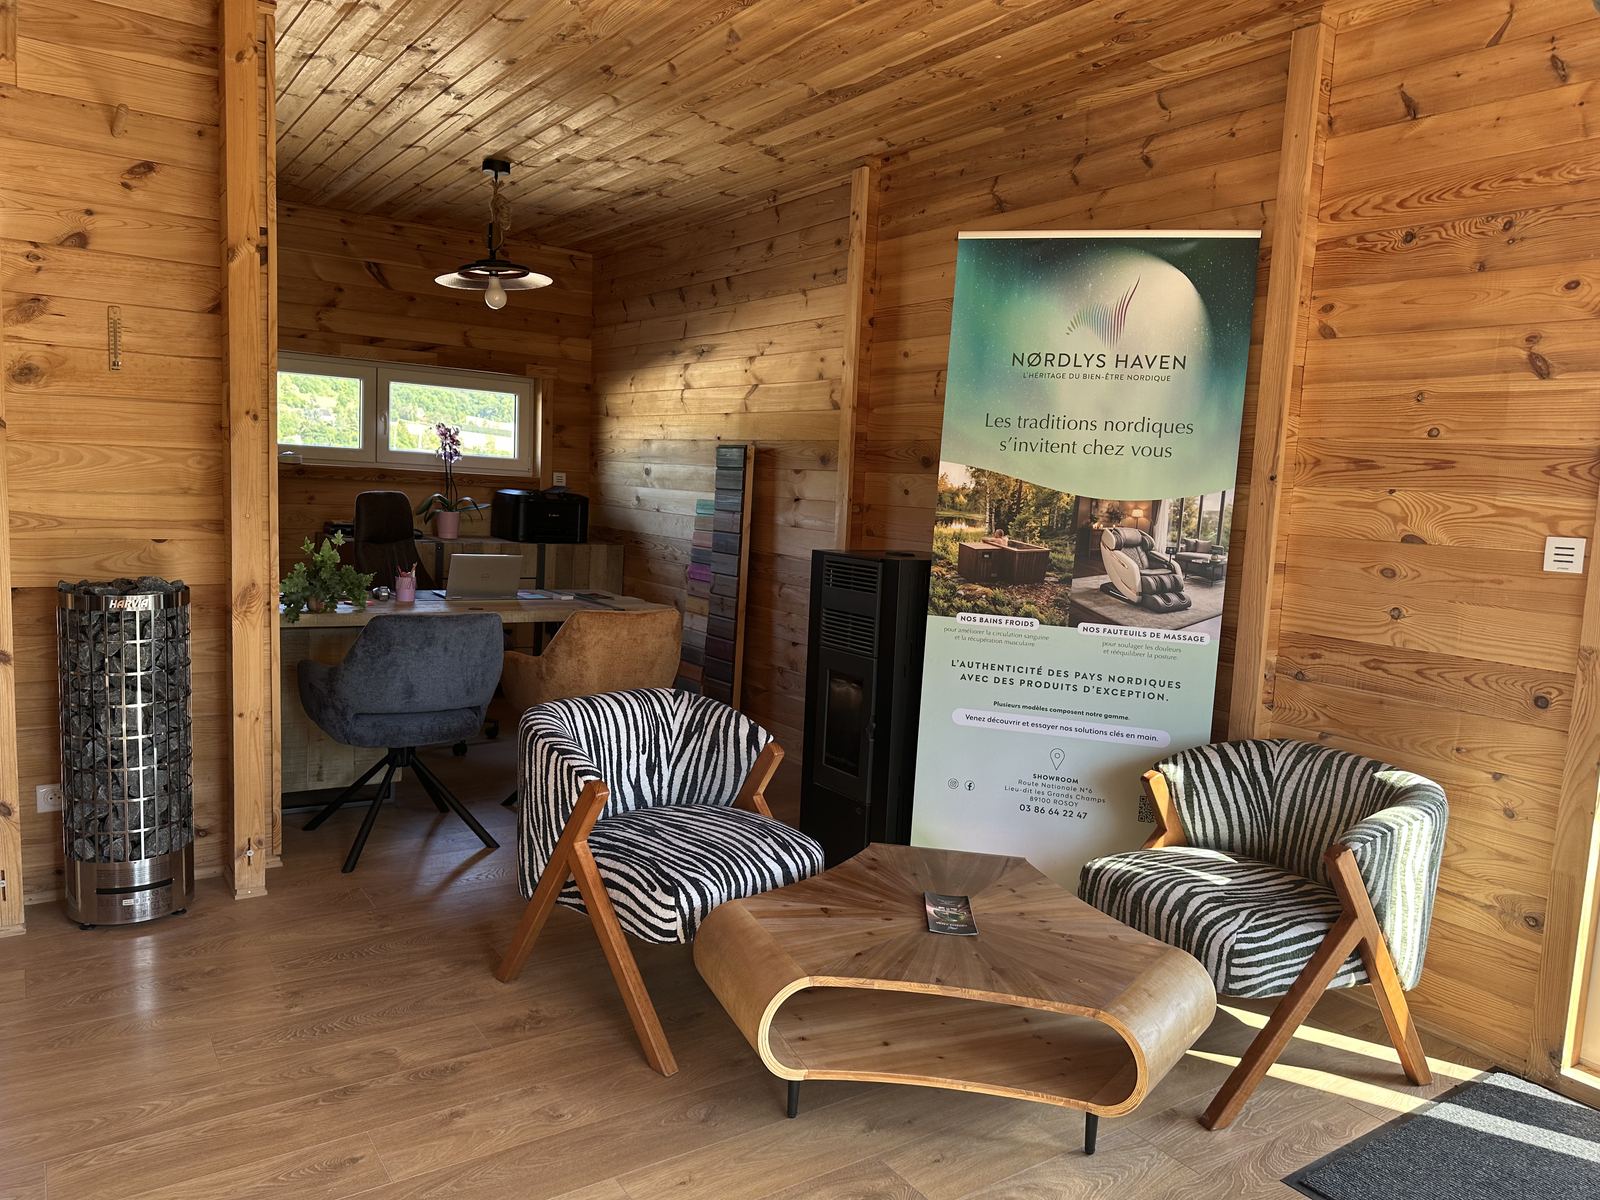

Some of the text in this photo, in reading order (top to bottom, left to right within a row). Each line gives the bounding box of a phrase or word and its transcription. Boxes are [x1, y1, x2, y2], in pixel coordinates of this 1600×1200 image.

[1012, 352, 1187, 370] NØRDLYS HAVEN
[1023, 371, 1067, 380] L'HÉRITAGE
[1083, 372, 1125, 381] BIEN-ÊTRE
[1127, 374, 1171, 383] NORDIQUE
[985, 413, 1194, 439] Les traditions nordiques
[999, 437, 1173, 458] s'invitent chez vous
[109, 599, 149, 609] HARVIA
[960, 615, 1034, 628] NOS BAINS FROIDS
[967, 636, 1003, 645] récupération
[1004, 638, 1036, 647] musculaire
[992, 629, 1023, 638] circulation
[1024, 633, 1050, 641] sanguine
[1082, 626, 1100, 634] NOS
[1102, 627, 1147, 638] FAUTEUILS
[1163, 633, 1205, 643] MASSAGE
[1118, 641, 1144, 651] soulager
[1154, 644, 1182, 653] douleurs
[951, 659, 1182, 689] L'AUTHENTICITÉ DES PAYS NORDIQUES
[960, 673, 1169, 702] AVEC DES PRODUITS D'EXCEPTION.
[993, 701, 1021, 709] Plusieurs
[1022, 704, 1048, 712] modèles
[1049, 707, 1084, 716] composent
[965, 714, 986, 722] Venez
[987, 716, 1020, 726] découvrir
[1030, 723, 1058, 731] essayer
[1074, 727, 1108, 736] solutions
[1109, 730, 1124, 738] clés
[1137, 734, 1159, 742] main.
[1018, 779, 1039, 787] Route
[1041, 782, 1078, 792] Nationale
[1033, 773, 1079, 784] SHOWROOM
[1004, 785, 1033, 794] Lieu-dit
[1047, 790, 1073, 799] Grands
[1075, 794, 1106, 804] Champs
[1029, 796, 1079, 807] 89100 ROSOY
[1019, 804, 1088, 820] 03 86 64 22 47
